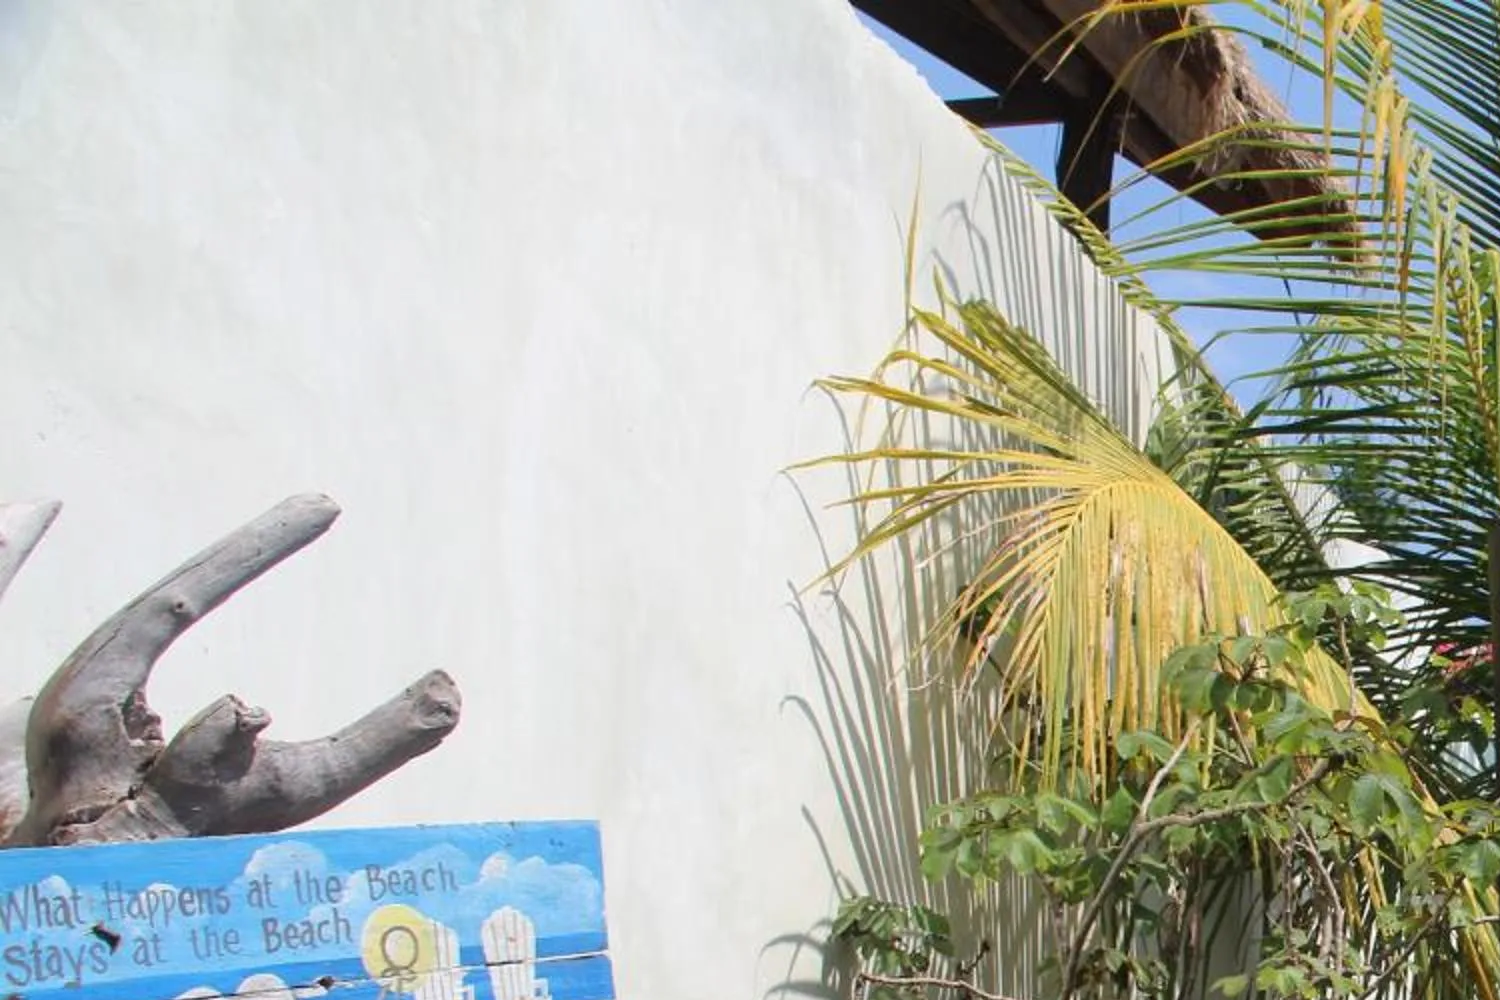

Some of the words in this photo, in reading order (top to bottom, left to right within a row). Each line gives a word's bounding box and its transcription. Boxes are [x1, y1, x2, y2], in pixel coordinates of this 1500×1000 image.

[0, 884, 85, 933] What
[102, 881, 230, 928] Happens
[247, 873, 279, 909] at
[294, 869, 342, 904] the
[366, 861, 459, 901] Beach
[4, 935, 109, 988] Stays
[132, 933, 168, 966] at
[191, 926, 241, 960] the
[261, 907, 353, 954] Beach
